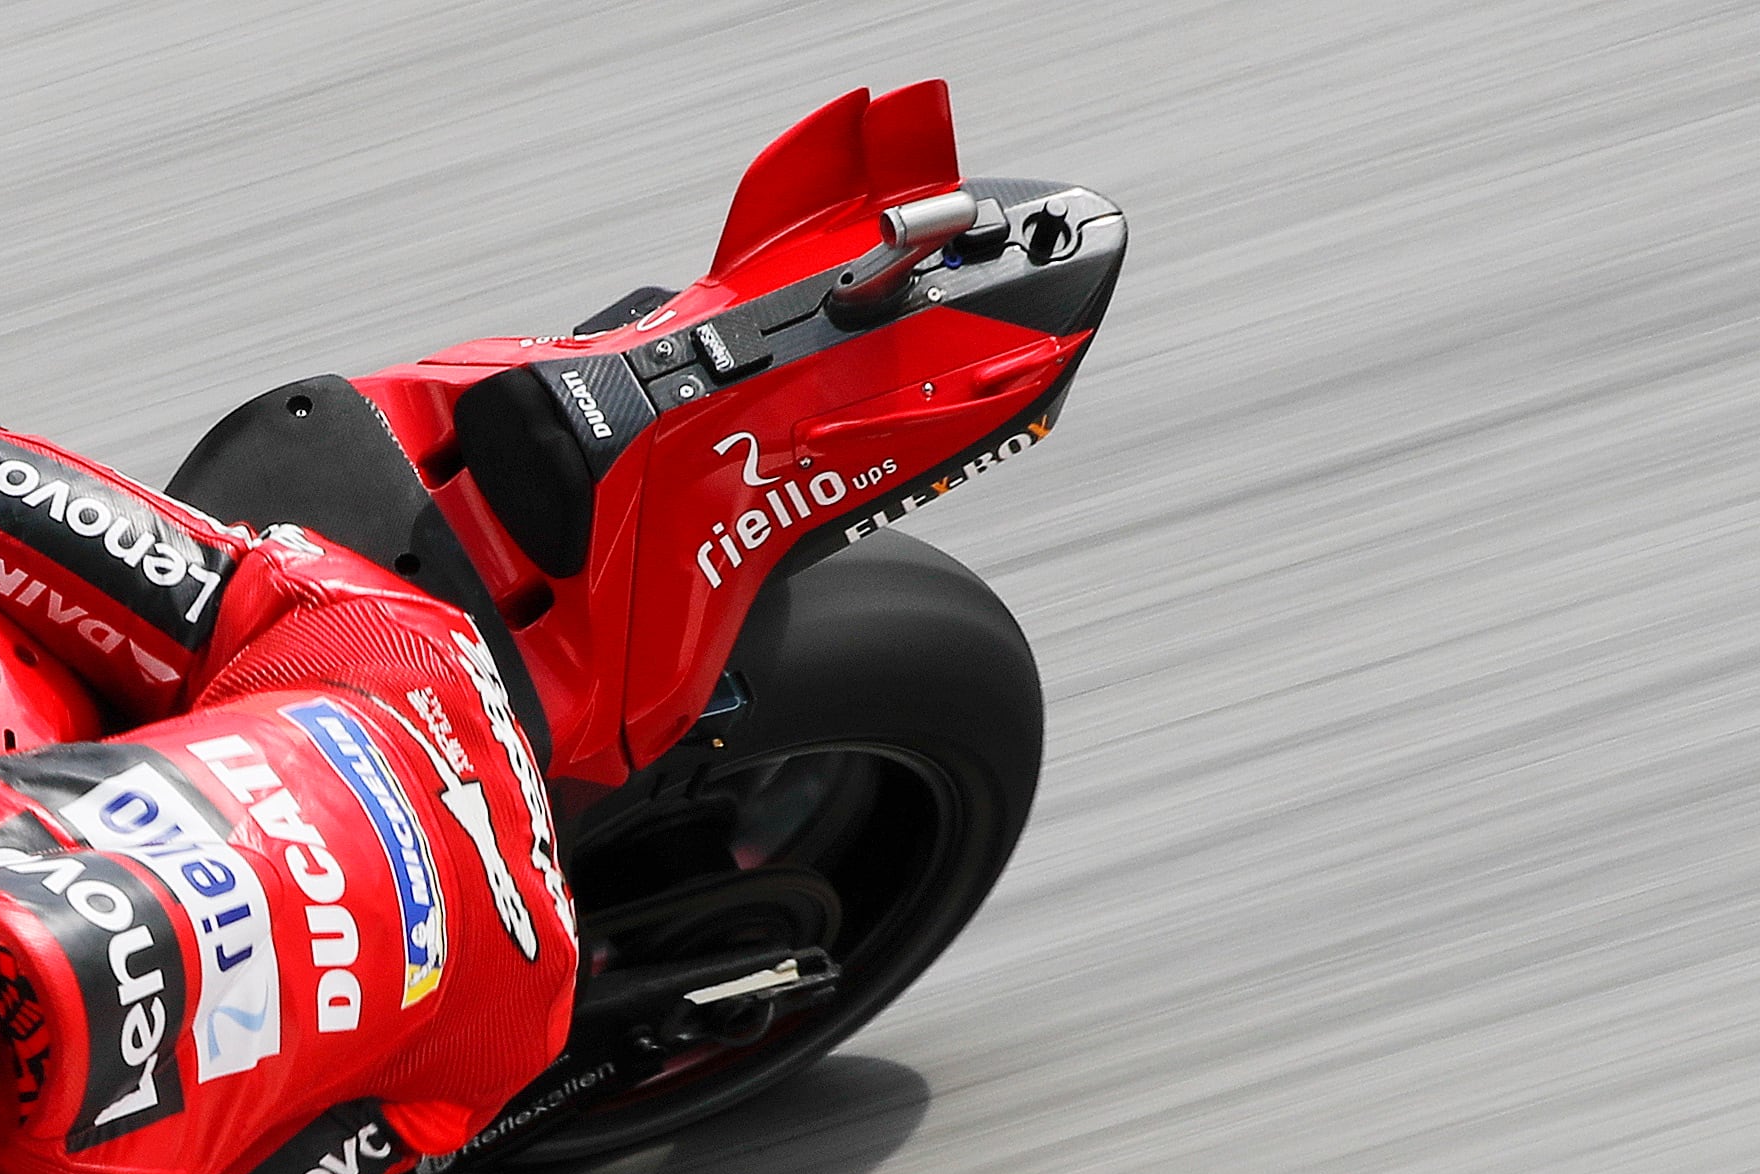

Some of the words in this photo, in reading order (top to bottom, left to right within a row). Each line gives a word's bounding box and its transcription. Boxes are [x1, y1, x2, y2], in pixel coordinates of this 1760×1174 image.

[560, 368, 612, 440] DUCATI
[696, 470, 848, 589] riello
[852, 456, 898, 491] ups
[98, 787, 253, 975] riello
[186, 734, 362, 1034] DUCATI
[316, 715, 436, 912] MICHELIN
